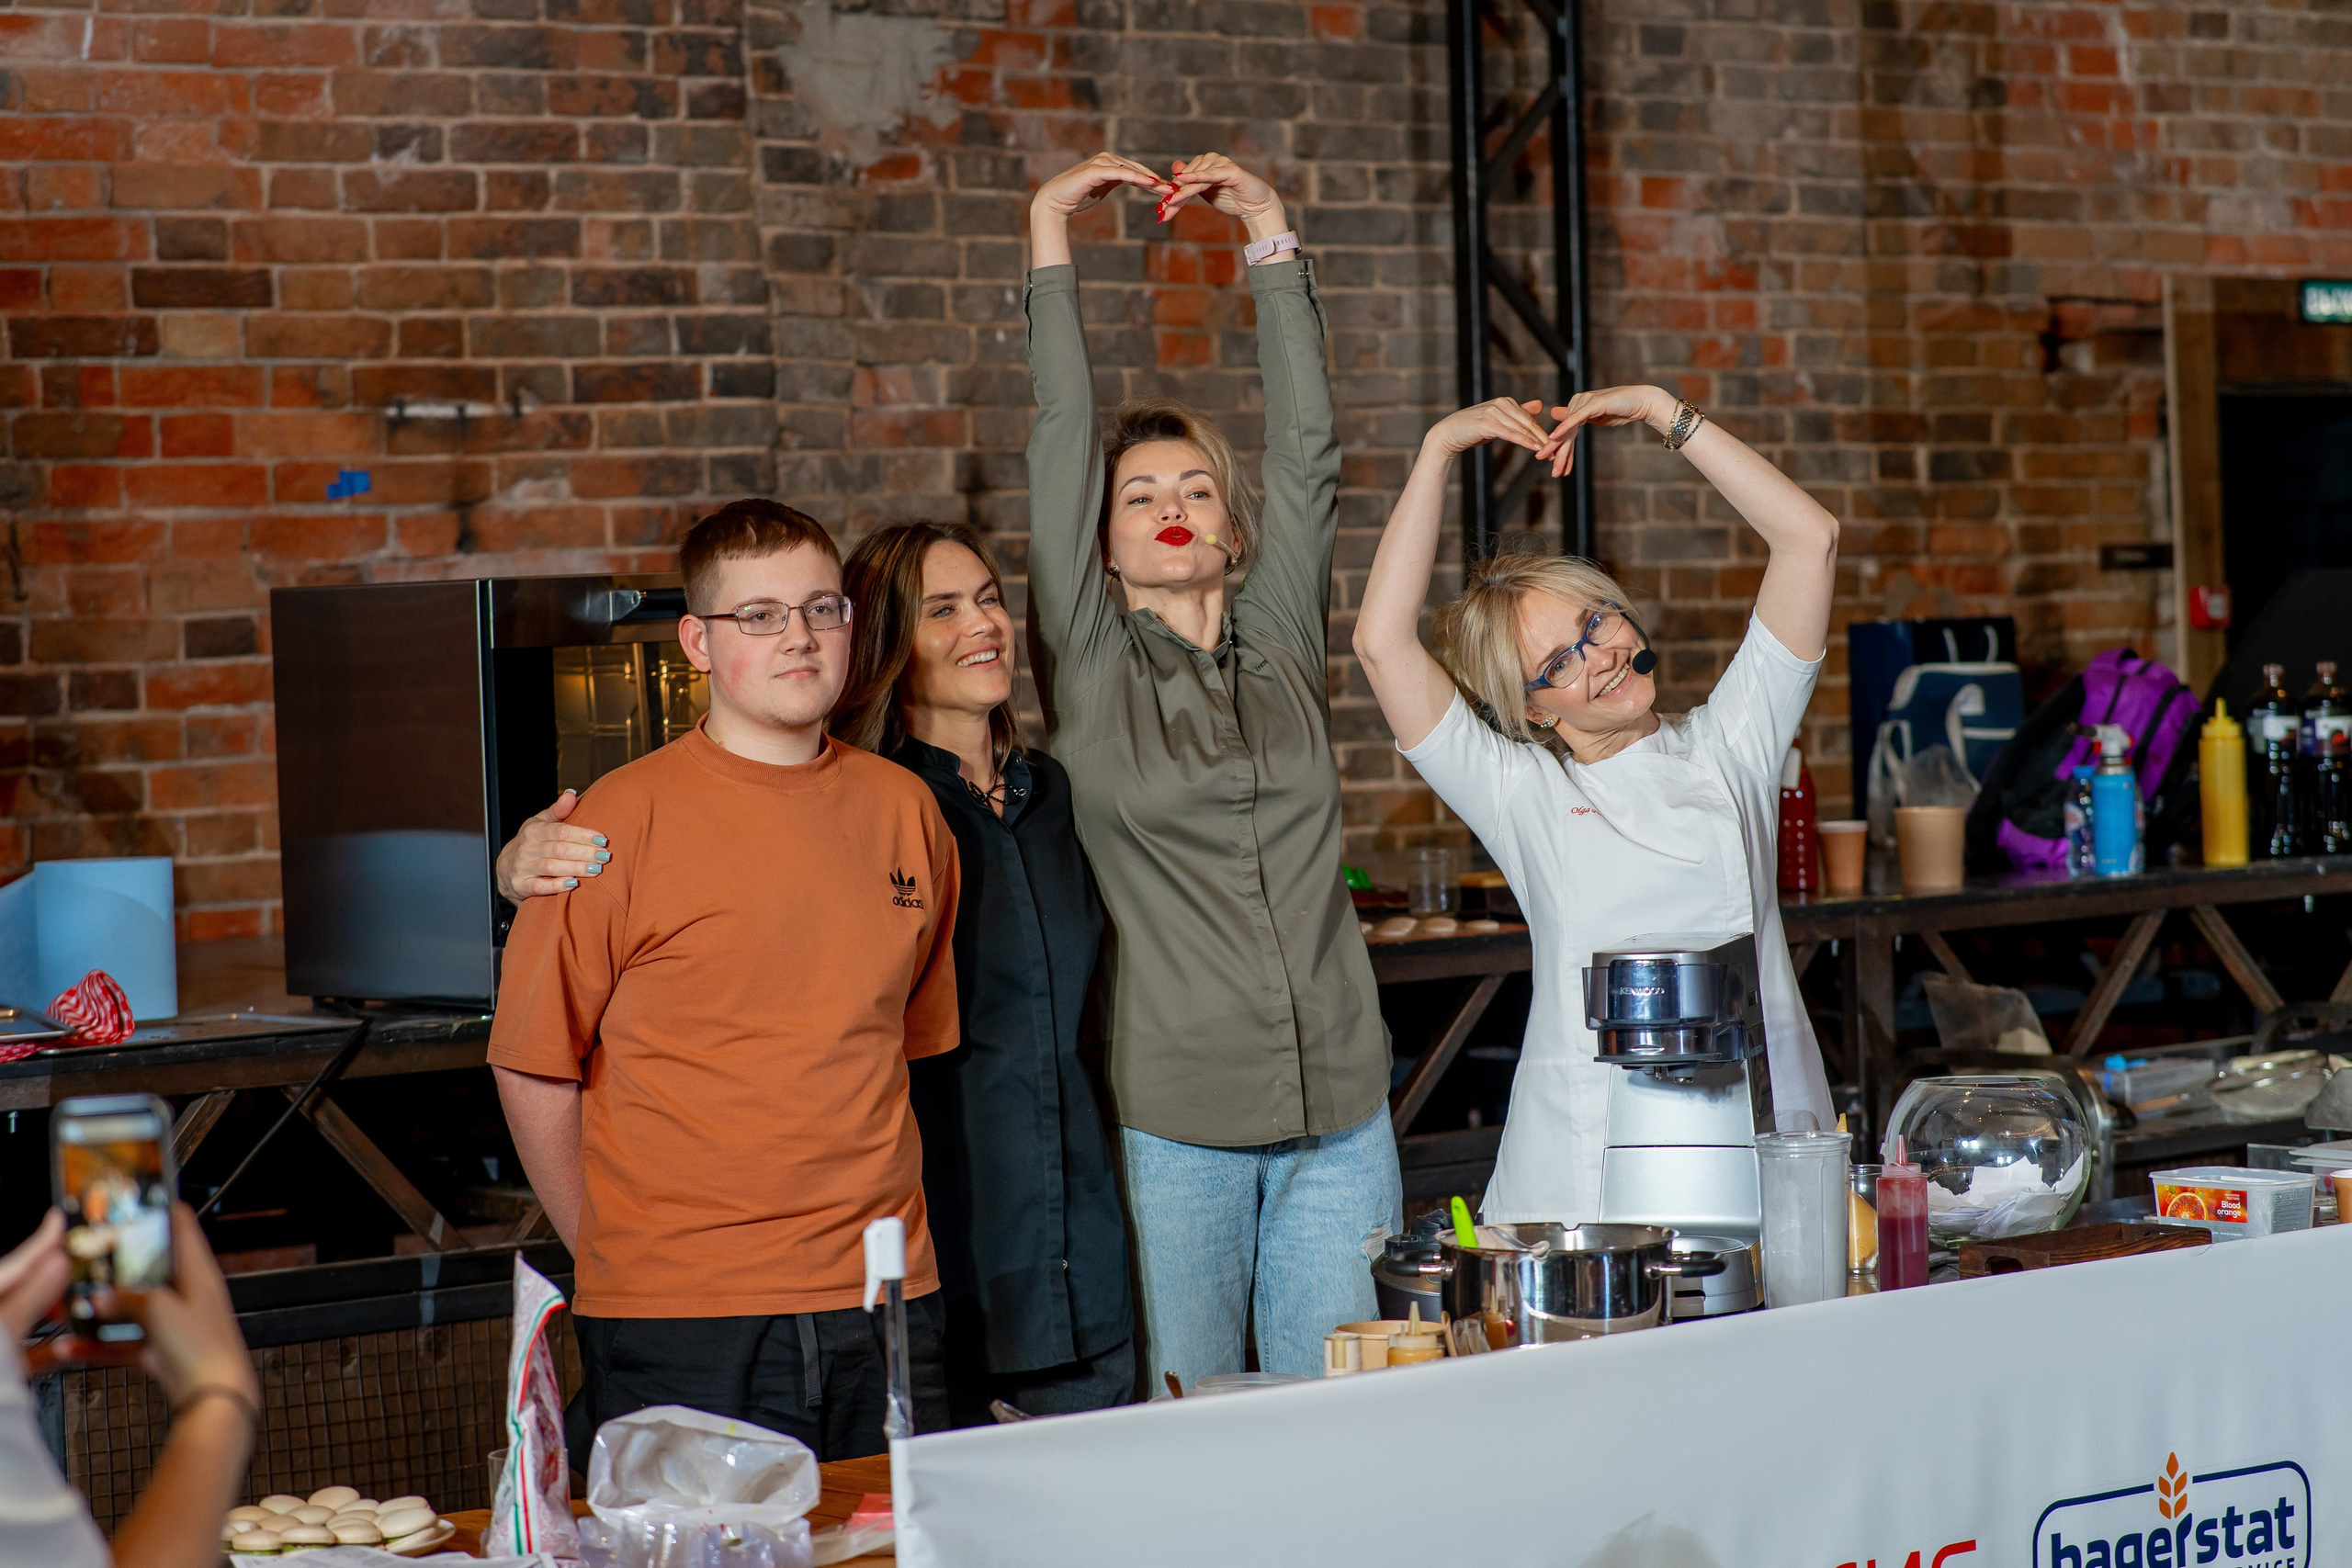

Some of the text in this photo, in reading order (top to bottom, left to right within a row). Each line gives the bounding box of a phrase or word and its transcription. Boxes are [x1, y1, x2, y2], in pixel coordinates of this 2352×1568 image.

[1571, 807, 1590, 815] Olga
[892, 897, 924, 909] adidas
[1620, 987, 1665, 996] KENWOOD
[2221, 1201, 2241, 1209] Blood
[2217, 1209, 2242, 1218] orange
